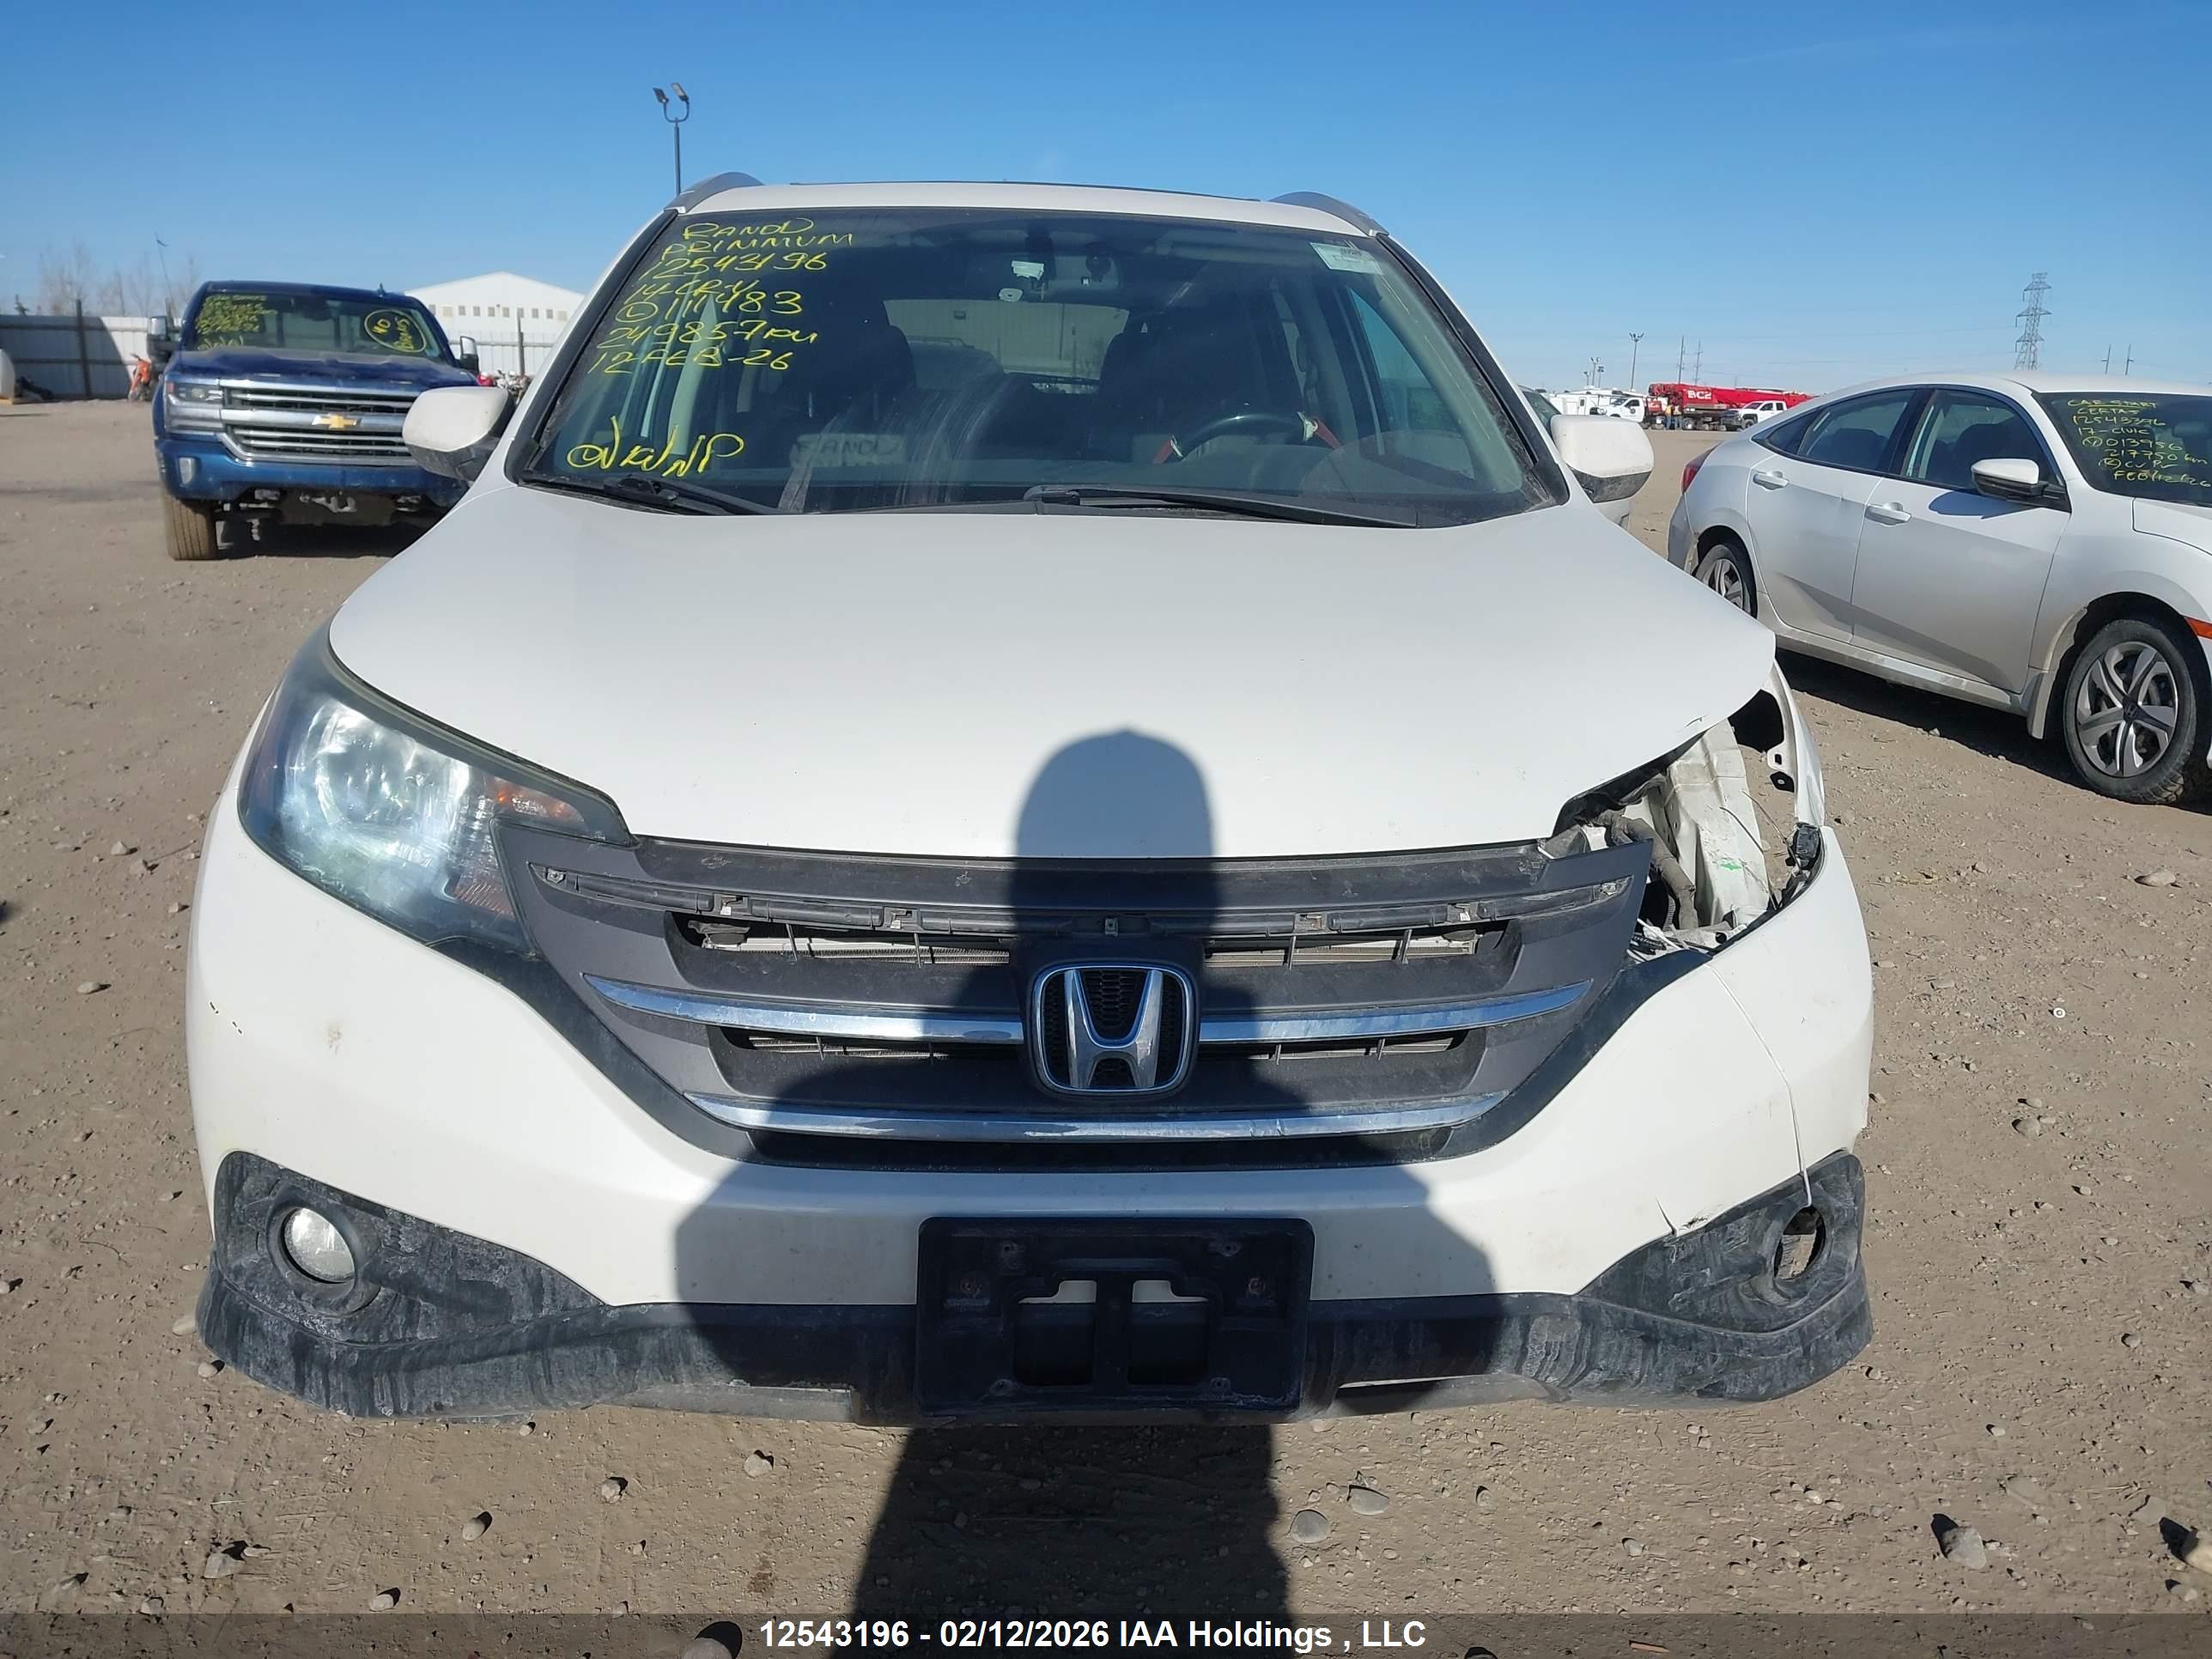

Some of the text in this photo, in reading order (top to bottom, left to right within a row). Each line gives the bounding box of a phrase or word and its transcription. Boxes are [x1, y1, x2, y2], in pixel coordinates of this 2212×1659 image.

[662, 233, 854, 260] PRIMMUM
[638, 252, 828, 281] 12543196
[664, 290, 804, 320] 111483
[2104, 448, 2178, 460] 217750
[2106, 438, 2183, 451] 013956
